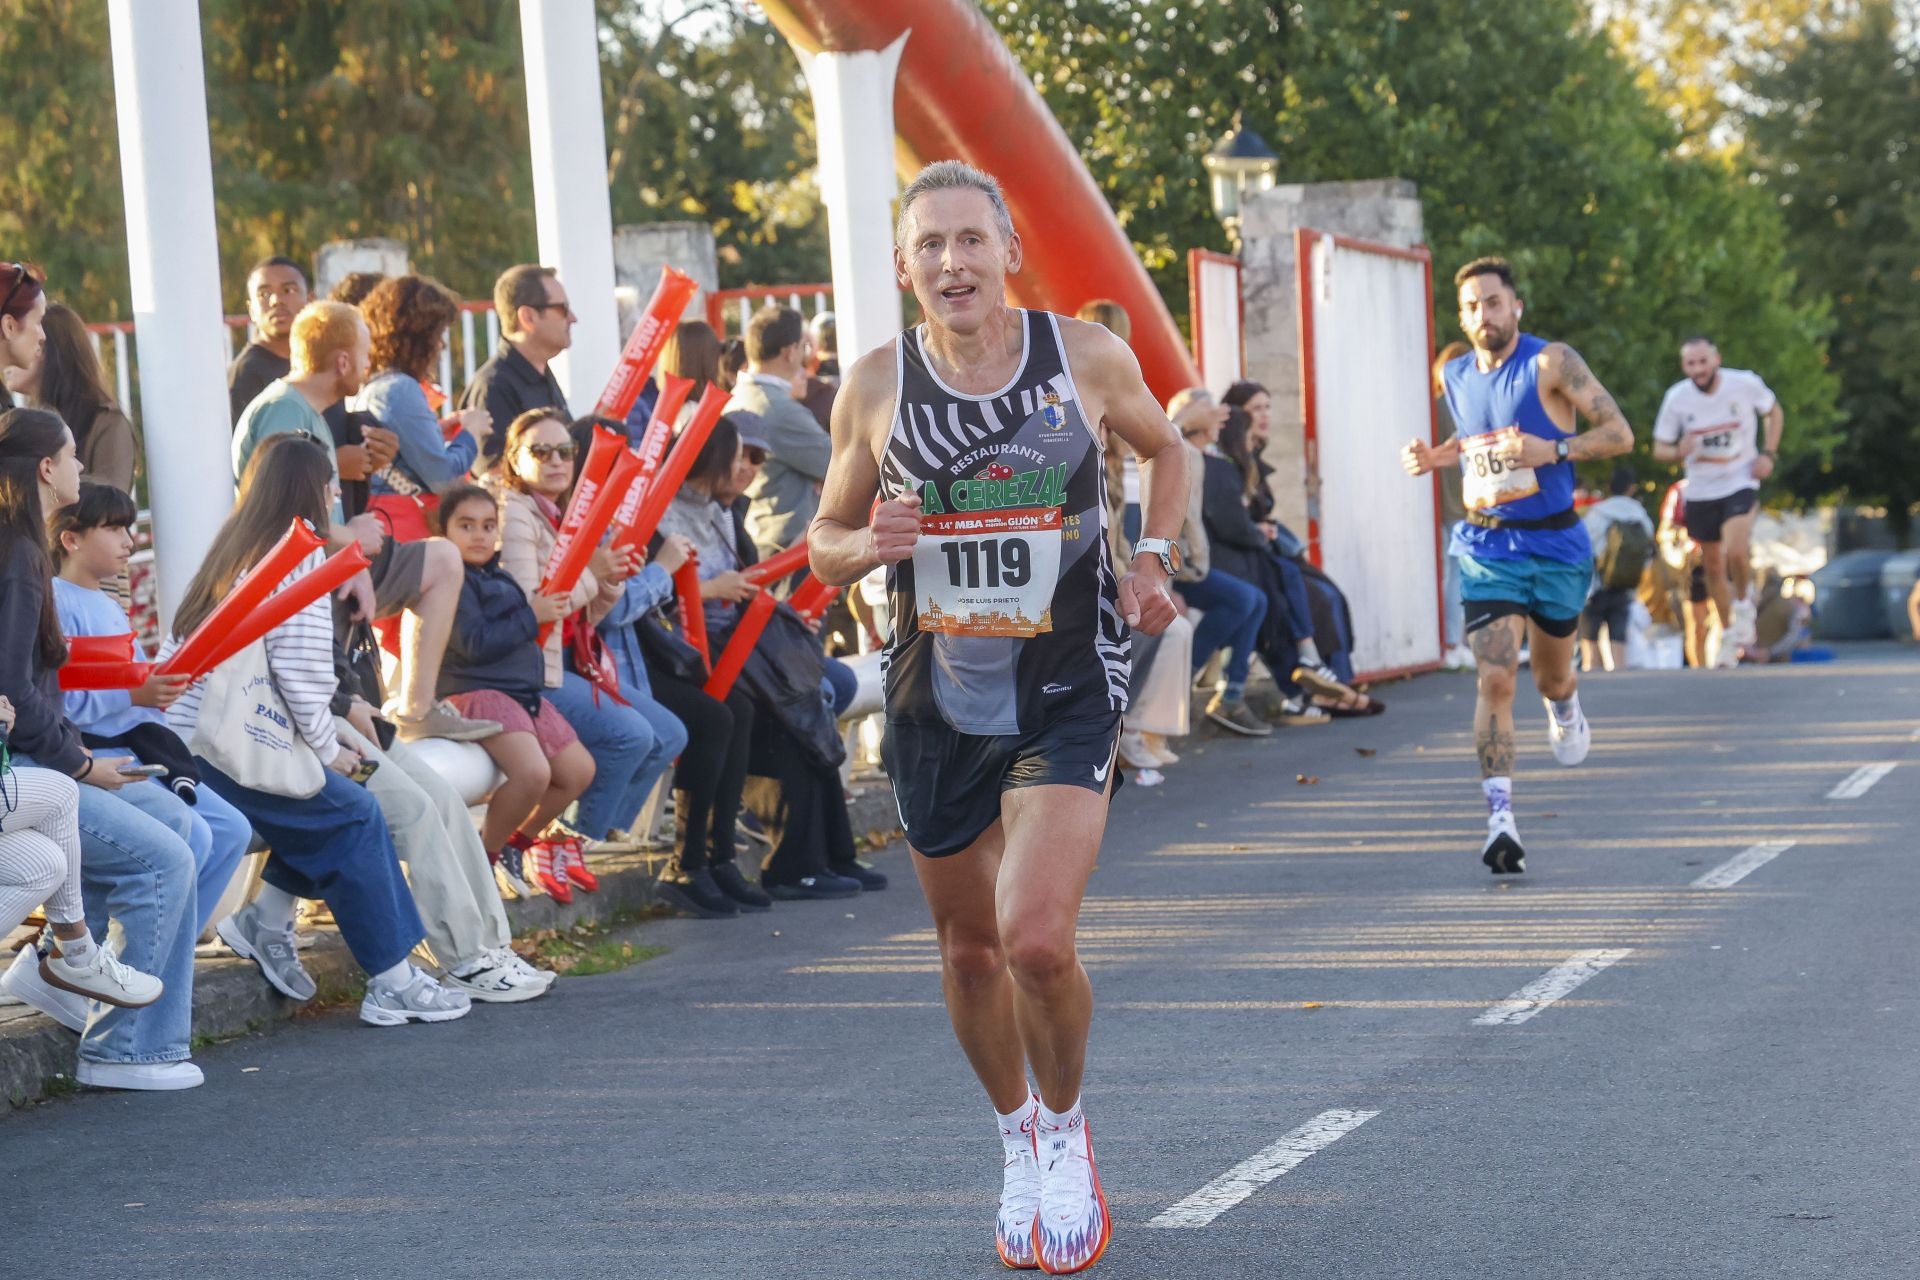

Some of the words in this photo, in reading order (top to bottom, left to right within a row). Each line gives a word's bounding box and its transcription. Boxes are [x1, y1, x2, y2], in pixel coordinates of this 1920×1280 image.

[626, 315, 660, 360] MBA
[602, 363, 632, 406] MBA
[642, 420, 669, 471] MBA
[950, 443, 1047, 475] RESTAURANTE
[568, 478, 598, 528] MBA
[617, 475, 647, 526] MBA
[903, 477, 945, 516] A
[950, 461, 1067, 512] CEREZAL
[955, 519, 984, 529] MBA
[1008, 515, 1039, 526] GIJÓN
[1062, 514, 1081, 527] TES
[1062, 529, 1080, 541] INO
[545, 534, 573, 580] MBA
[940, 537, 1031, 588] 1119
